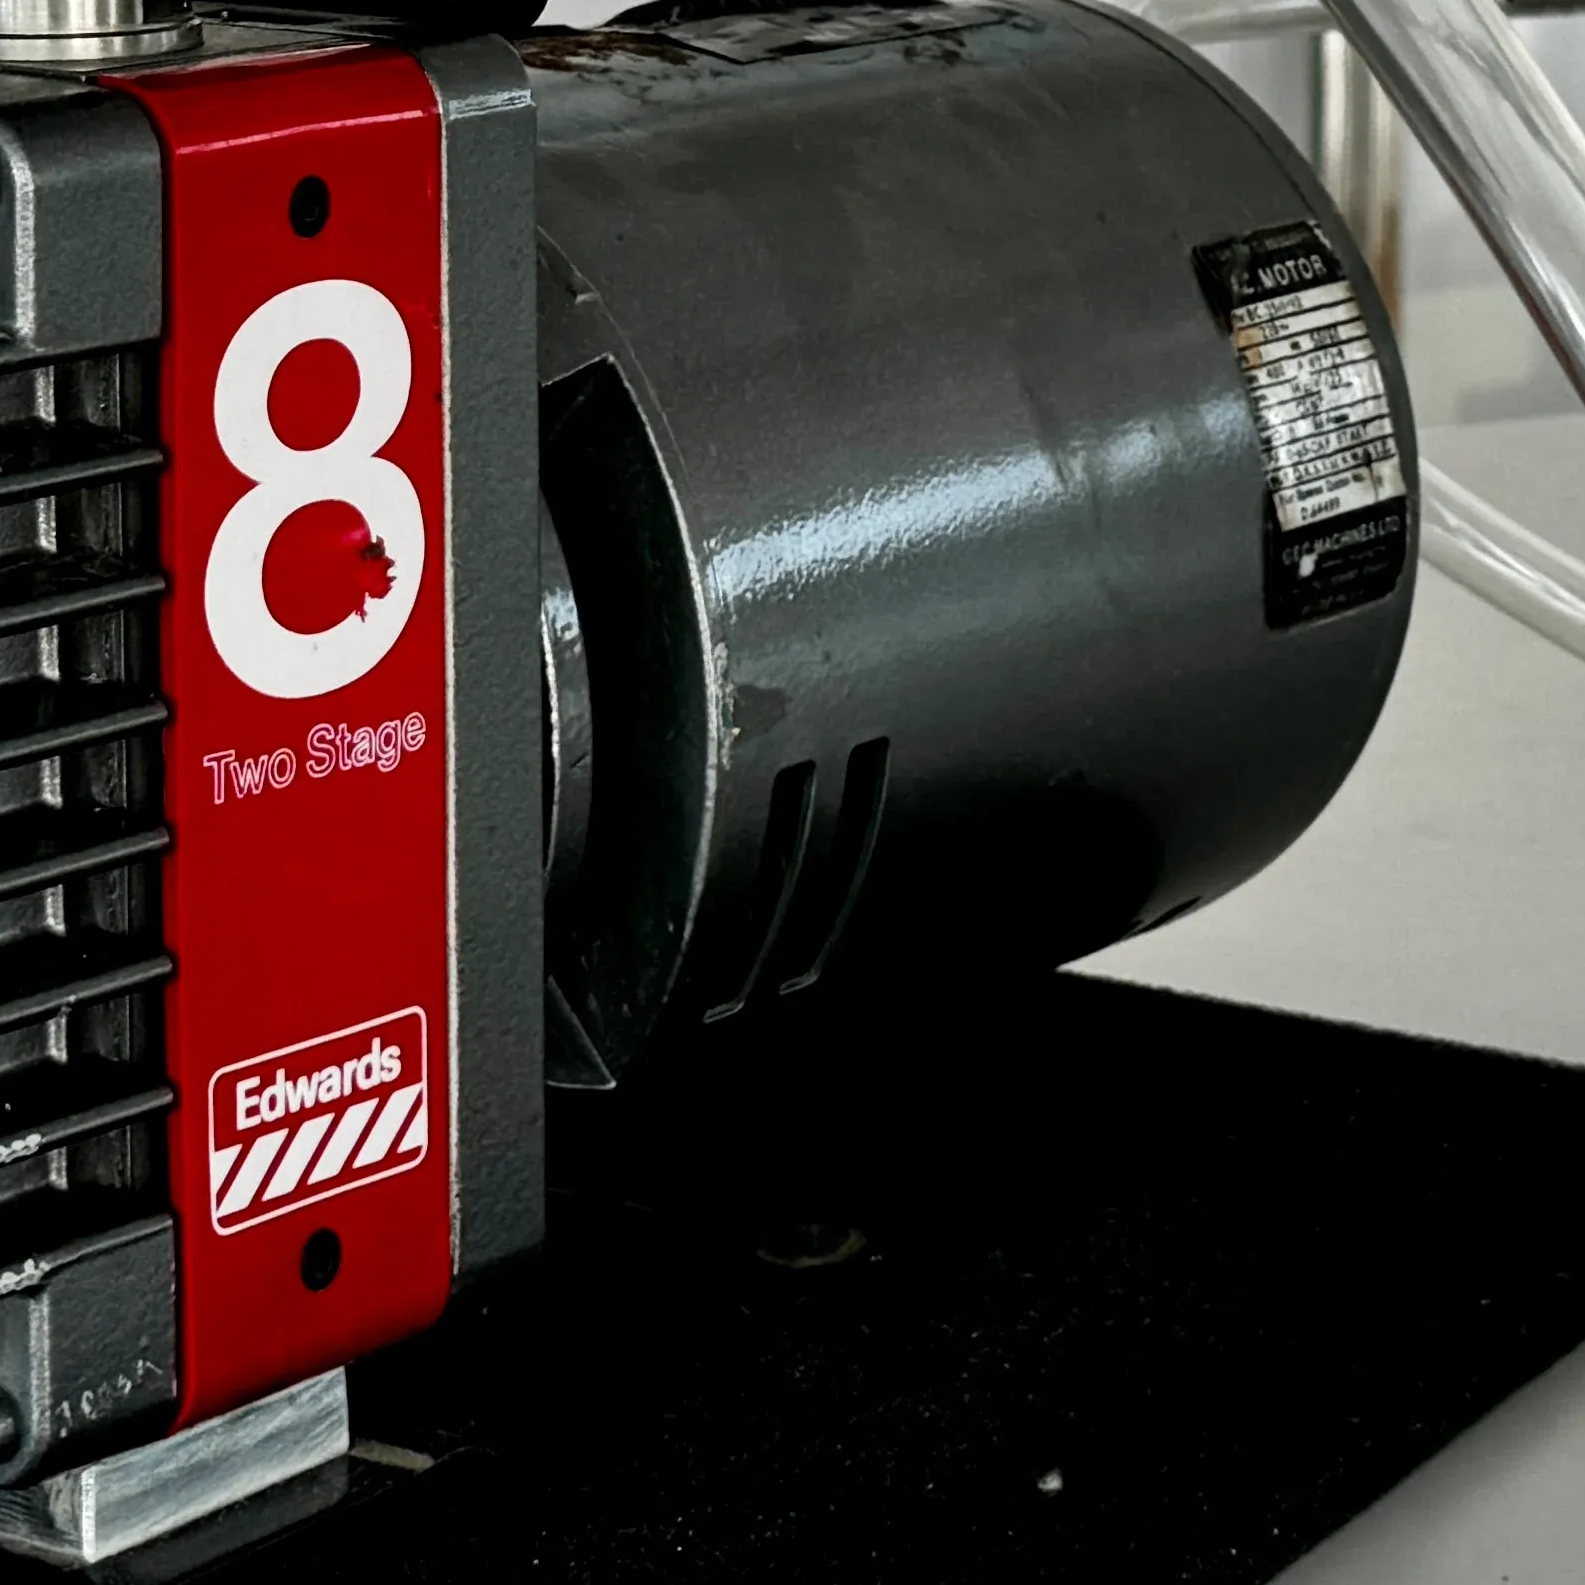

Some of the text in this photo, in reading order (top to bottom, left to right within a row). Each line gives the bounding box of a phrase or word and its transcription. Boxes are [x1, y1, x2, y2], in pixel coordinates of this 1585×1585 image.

[204, 279, 425, 699] 8
[203, 711, 426, 805] Two Stage
[236, 1037, 402, 1131] Edwards
